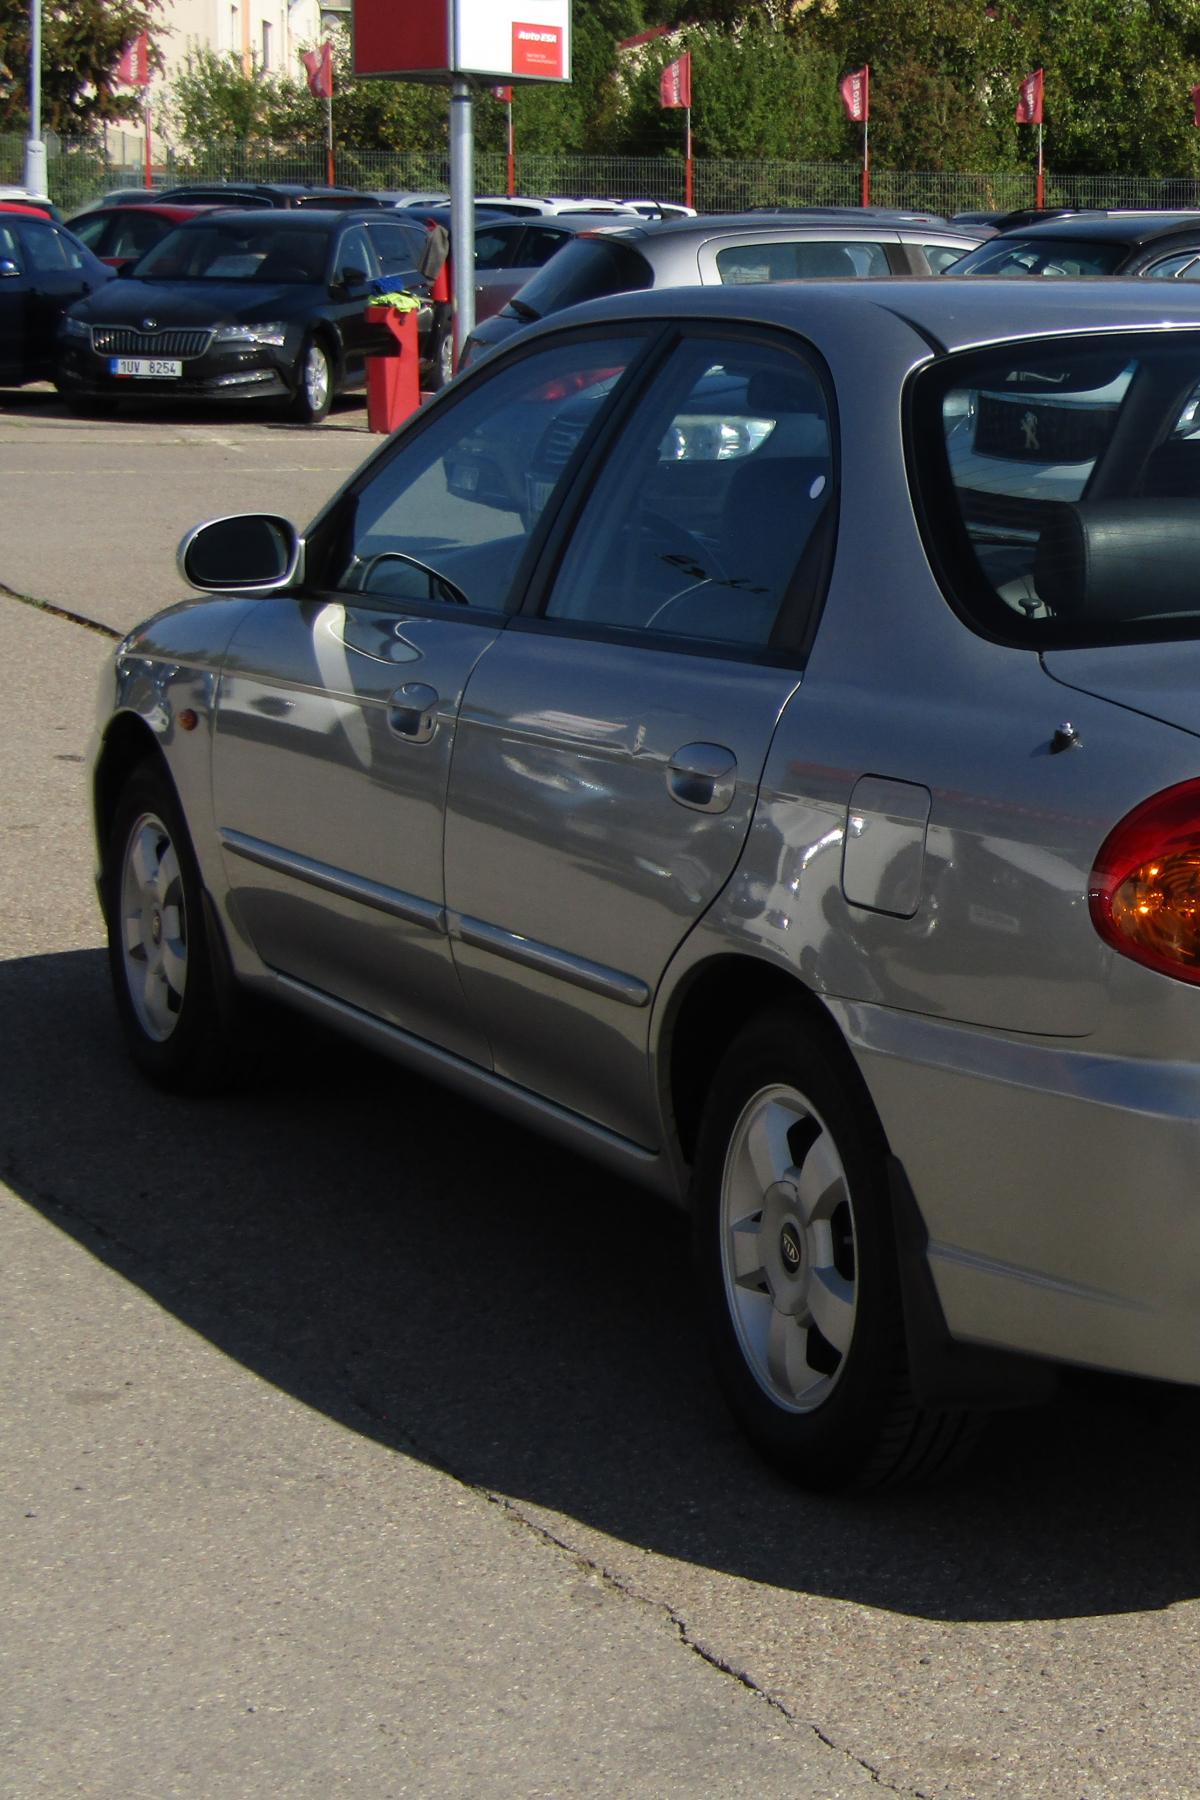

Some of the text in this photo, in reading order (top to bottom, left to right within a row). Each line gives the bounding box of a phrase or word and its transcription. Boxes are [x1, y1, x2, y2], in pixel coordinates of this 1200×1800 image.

[518, 31, 557, 43] Auto ESA
[121, 361, 177, 375] 1UV 8254
